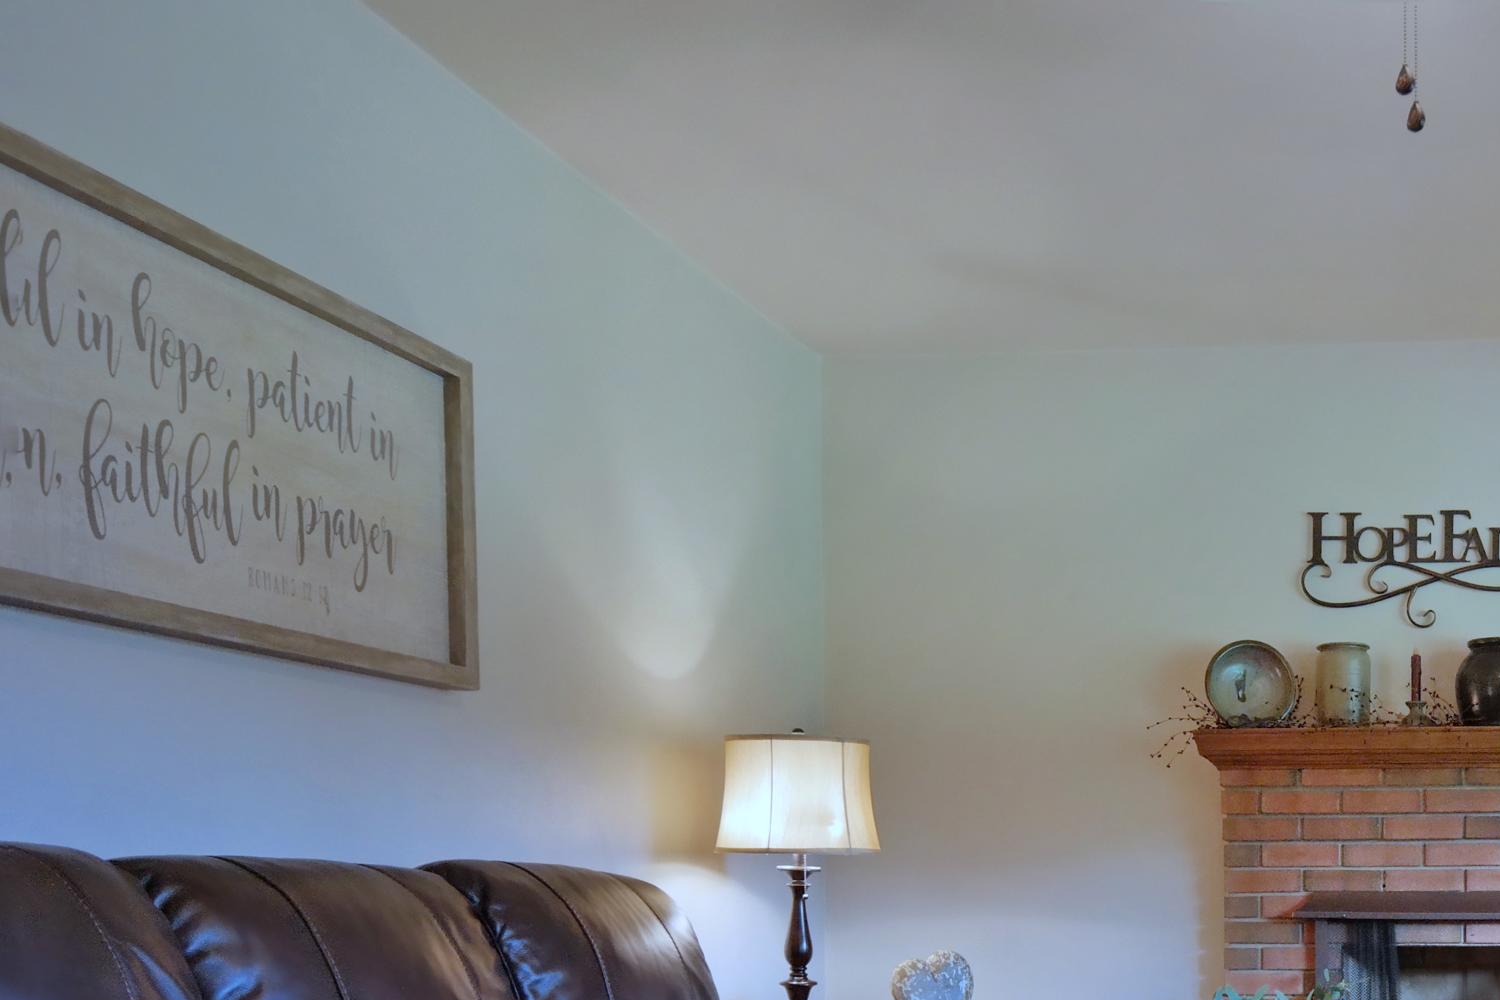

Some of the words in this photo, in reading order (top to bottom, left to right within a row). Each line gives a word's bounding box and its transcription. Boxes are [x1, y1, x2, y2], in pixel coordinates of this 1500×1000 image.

[77, 288, 122, 378] in
[246, 350, 362, 454] patient
[370, 411, 399, 481] in
[78, 398, 244, 565] faithful
[252, 464, 288, 542] in
[296, 495, 397, 592] prayer
